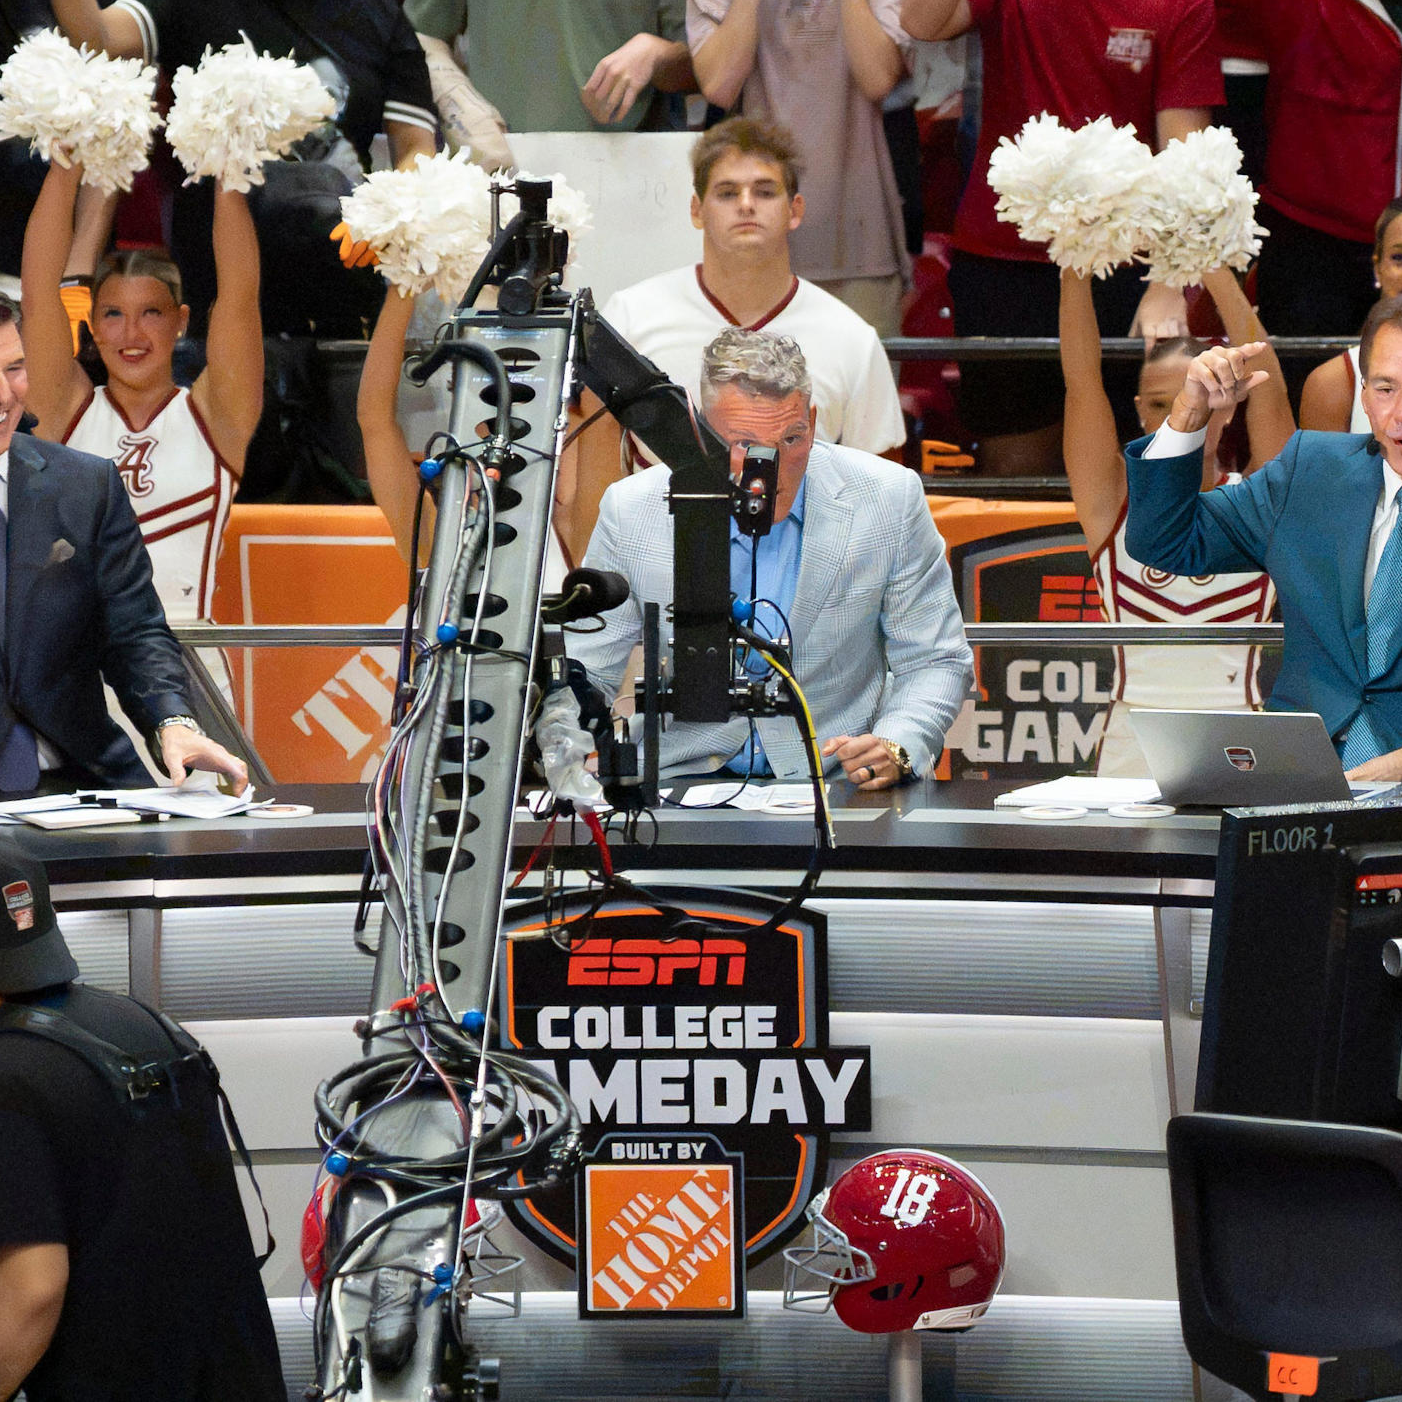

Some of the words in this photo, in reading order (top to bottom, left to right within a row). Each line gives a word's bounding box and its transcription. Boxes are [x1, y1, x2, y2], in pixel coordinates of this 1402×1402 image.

[1248, 826, 1316, 857] FLOOR
[1323, 823, 1337, 851] 1
[567, 938, 747, 986] ESPN
[536, 1005, 777, 1049] COLLEGE
[488, 1059, 865, 1125] AMEDAY
[611, 1142, 673, 1160] BUILT
[677, 1142, 707, 1160] BY
[605, 1190, 663, 1241] THE
[879, 1167, 943, 1225] 18
[592, 1167, 732, 1310] HOME
[648, 1220, 732, 1310] DEPOT
